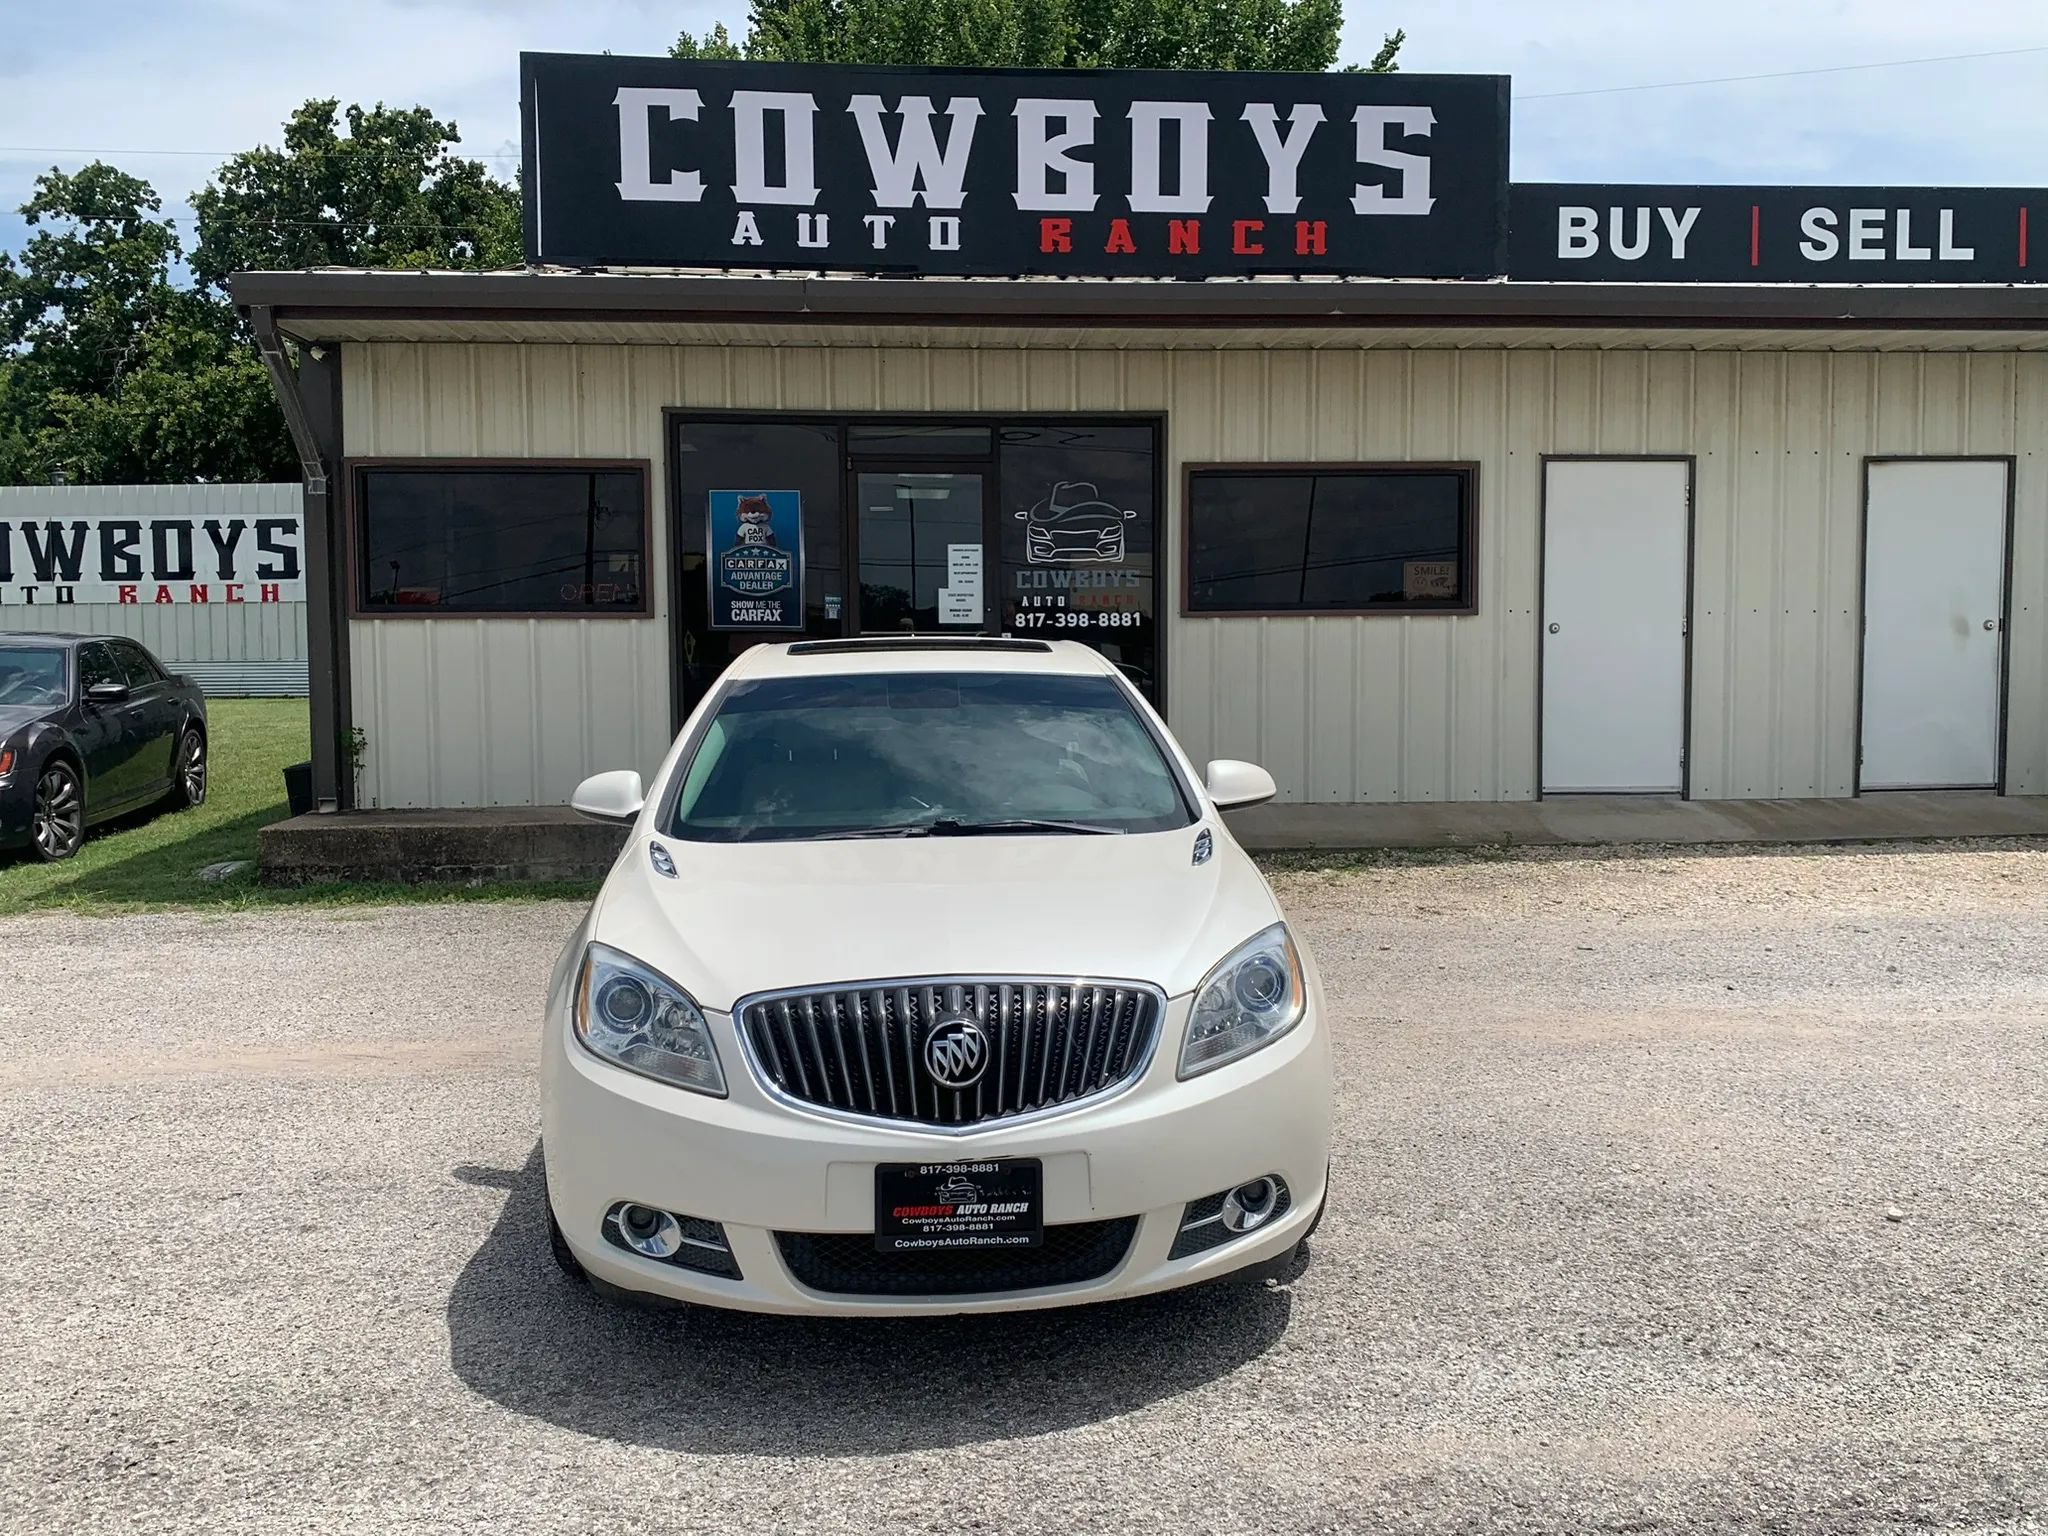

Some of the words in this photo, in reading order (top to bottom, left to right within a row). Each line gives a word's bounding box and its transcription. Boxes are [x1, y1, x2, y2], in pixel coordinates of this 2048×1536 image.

[612, 86, 1438, 216] COWBOYS
[730, 210, 962, 252] AUTO
[1039, 217, 1328, 256] RANCH
[1557, 206, 1701, 260] BUY
[1799, 208, 1975, 262] SELL
[748, 535, 764, 543] FOX
[726, 558, 787, 570] CARFAX
[730, 571, 783, 581] ADVANTAGE
[1016, 569, 1141, 589] COWBOYS
[740, 581, 774, 590] DEALER
[0, 585, 74, 604] TO
[118, 583, 281, 604] RANCH
[731, 600, 754, 609] SHOW
[755, 600, 767, 609] ME
[768, 600, 781, 609] THE
[1021, 595, 1066, 607] AUTO
[731, 608, 783, 622] CARFAX
[1015, 611, 1141, 628] 817-398-8881
[920, 1163, 1000, 1175] 817-398-8881
[893, 1205, 953, 1217] COWBOYS
[956, 1204, 988, 1215] AUTO
[989, 1202, 1029, 1214] RANCH
[902, 1215, 1016, 1224] CowboysAutoRanch.com
[922, 1223, 994, 1233] 817-398-8881
[894, 1236, 1030, 1249] CowboysAutoRanch.com
